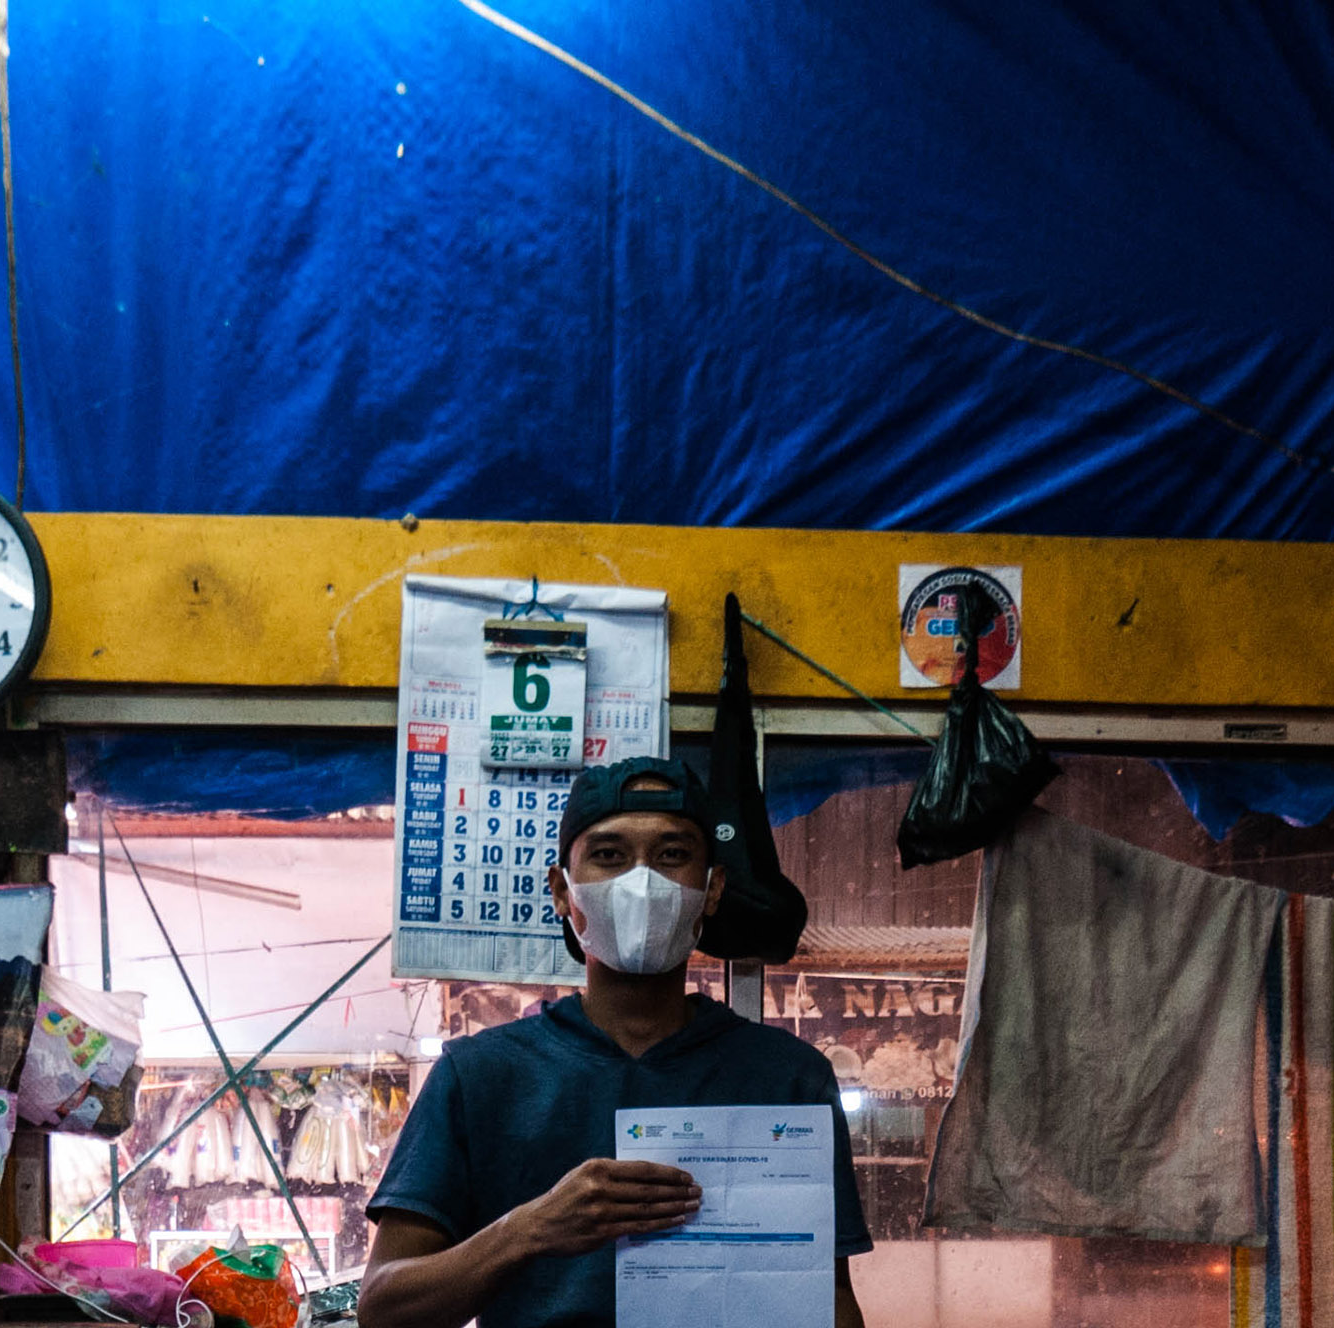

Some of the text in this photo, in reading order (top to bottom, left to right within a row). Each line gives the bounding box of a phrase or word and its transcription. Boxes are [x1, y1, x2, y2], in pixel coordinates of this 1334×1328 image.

[513, 653, 551, 713] 6
[504, 716, 559, 725] JUMAT
[409, 725, 607, 757] MINGGU 27
[490, 745, 508, 757] 27
[552, 745, 570, 757] 27
[410, 782, 442, 793] SELASA
[458, 788, 465, 806] 1
[488, 790, 501, 808] 8
[517, 791, 538, 810] 15
[412, 811, 559, 839] RABU 2 9 16 2
[409, 839, 559, 867] KAMIS 3 10 17 2
[407, 867, 437, 878] JUMAT
[452, 872, 465, 891] 4
[483, 873, 499, 892] 11
[513, 875, 534, 894] 18
[407, 895, 435, 906] SABTU
[451, 900, 464, 919] 5
[479, 901, 500, 921] 12
[512, 903, 533, 923] 19
